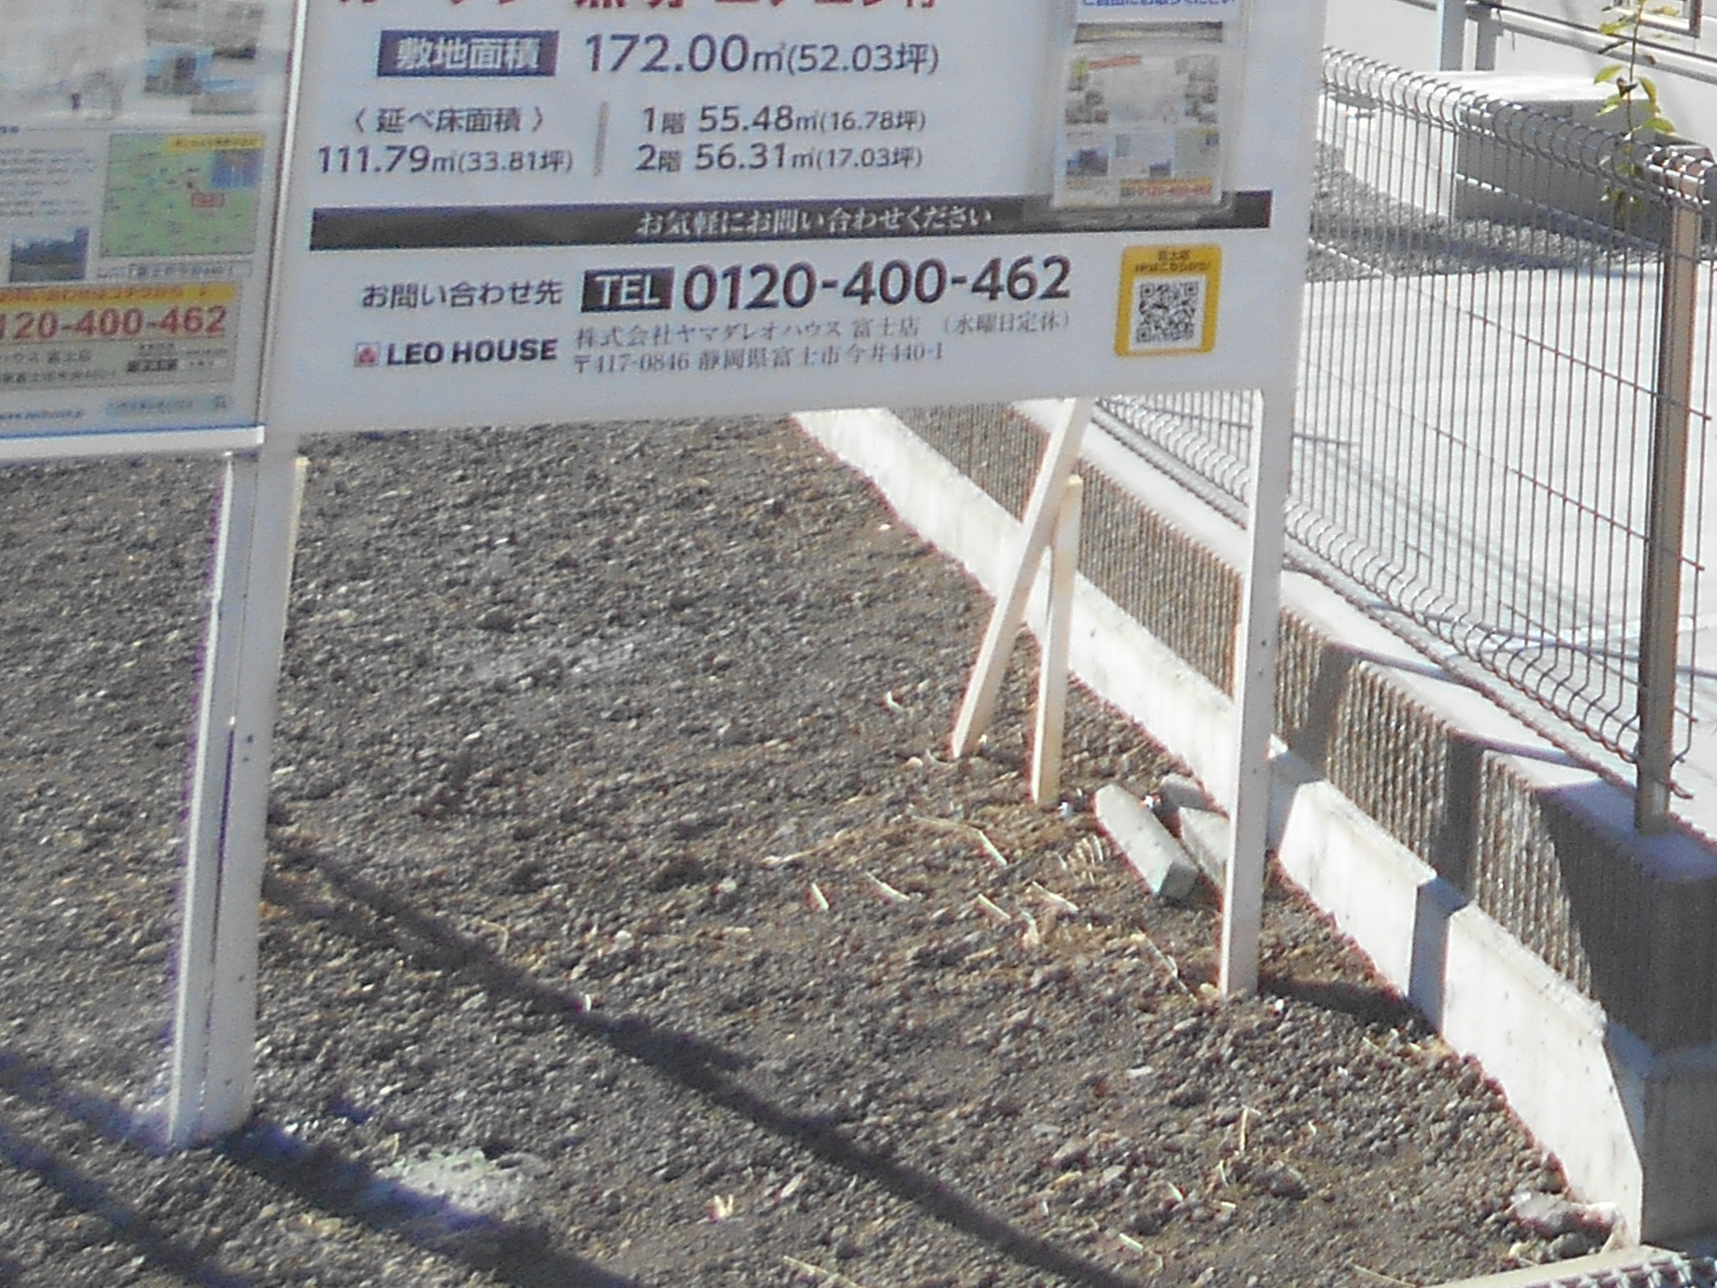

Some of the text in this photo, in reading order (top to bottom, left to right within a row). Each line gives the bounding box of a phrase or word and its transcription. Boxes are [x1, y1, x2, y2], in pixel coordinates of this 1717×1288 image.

[396, 36, 541, 72] 敷地面積
[642, 105, 687, 135] 1階
[635, 143, 683, 173] 2階
[635, 206, 993, 238] お気軽にお問い合わせください
[361, 279, 564, 310] お問い合わせ先
[595, 253, 1072, 312] TEL 0120-400-462
[575, 320, 842, 350] 株式会社ヤマダレオハウス
[387, 338, 560, 367] LEO HOUSE
